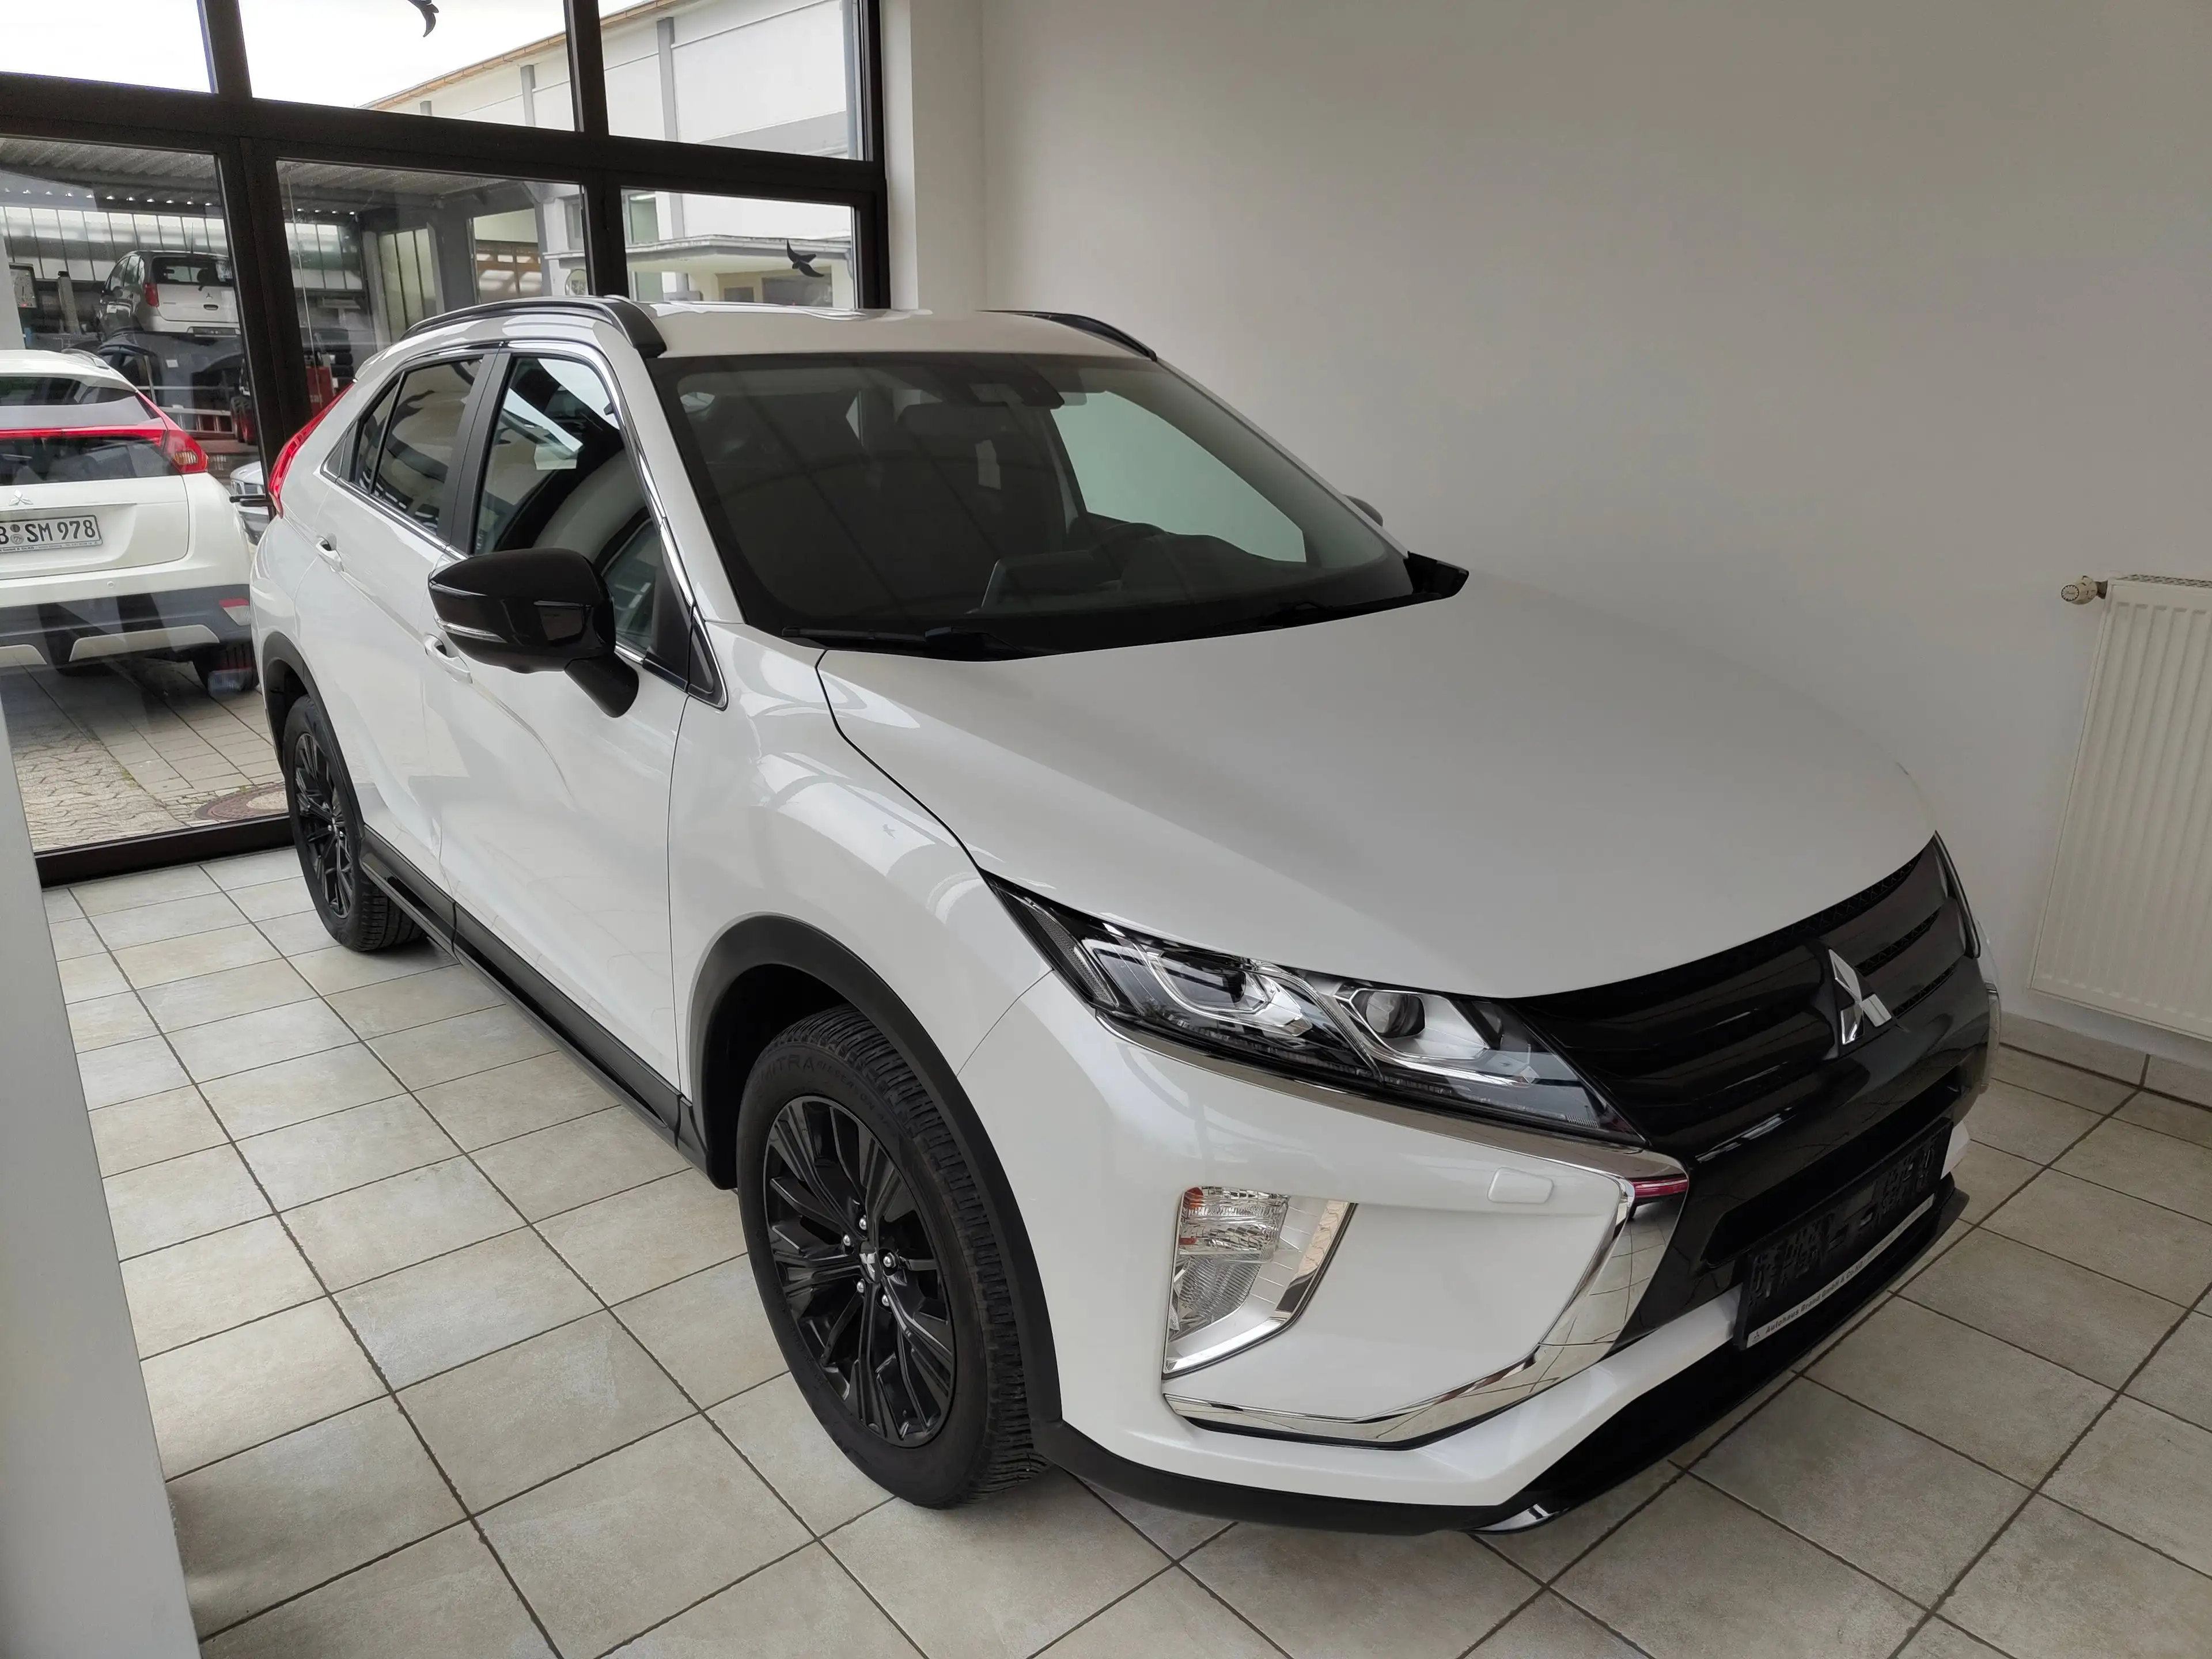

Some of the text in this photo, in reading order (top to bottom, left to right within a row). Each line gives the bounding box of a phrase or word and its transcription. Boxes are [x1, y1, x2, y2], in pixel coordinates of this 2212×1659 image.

[25, 523, 53, 542] SM
[57, 520, 96, 540] 978
[1765, 1309, 1800, 1334] Autohaus
[1801, 1294, 1821, 1312] Brand
